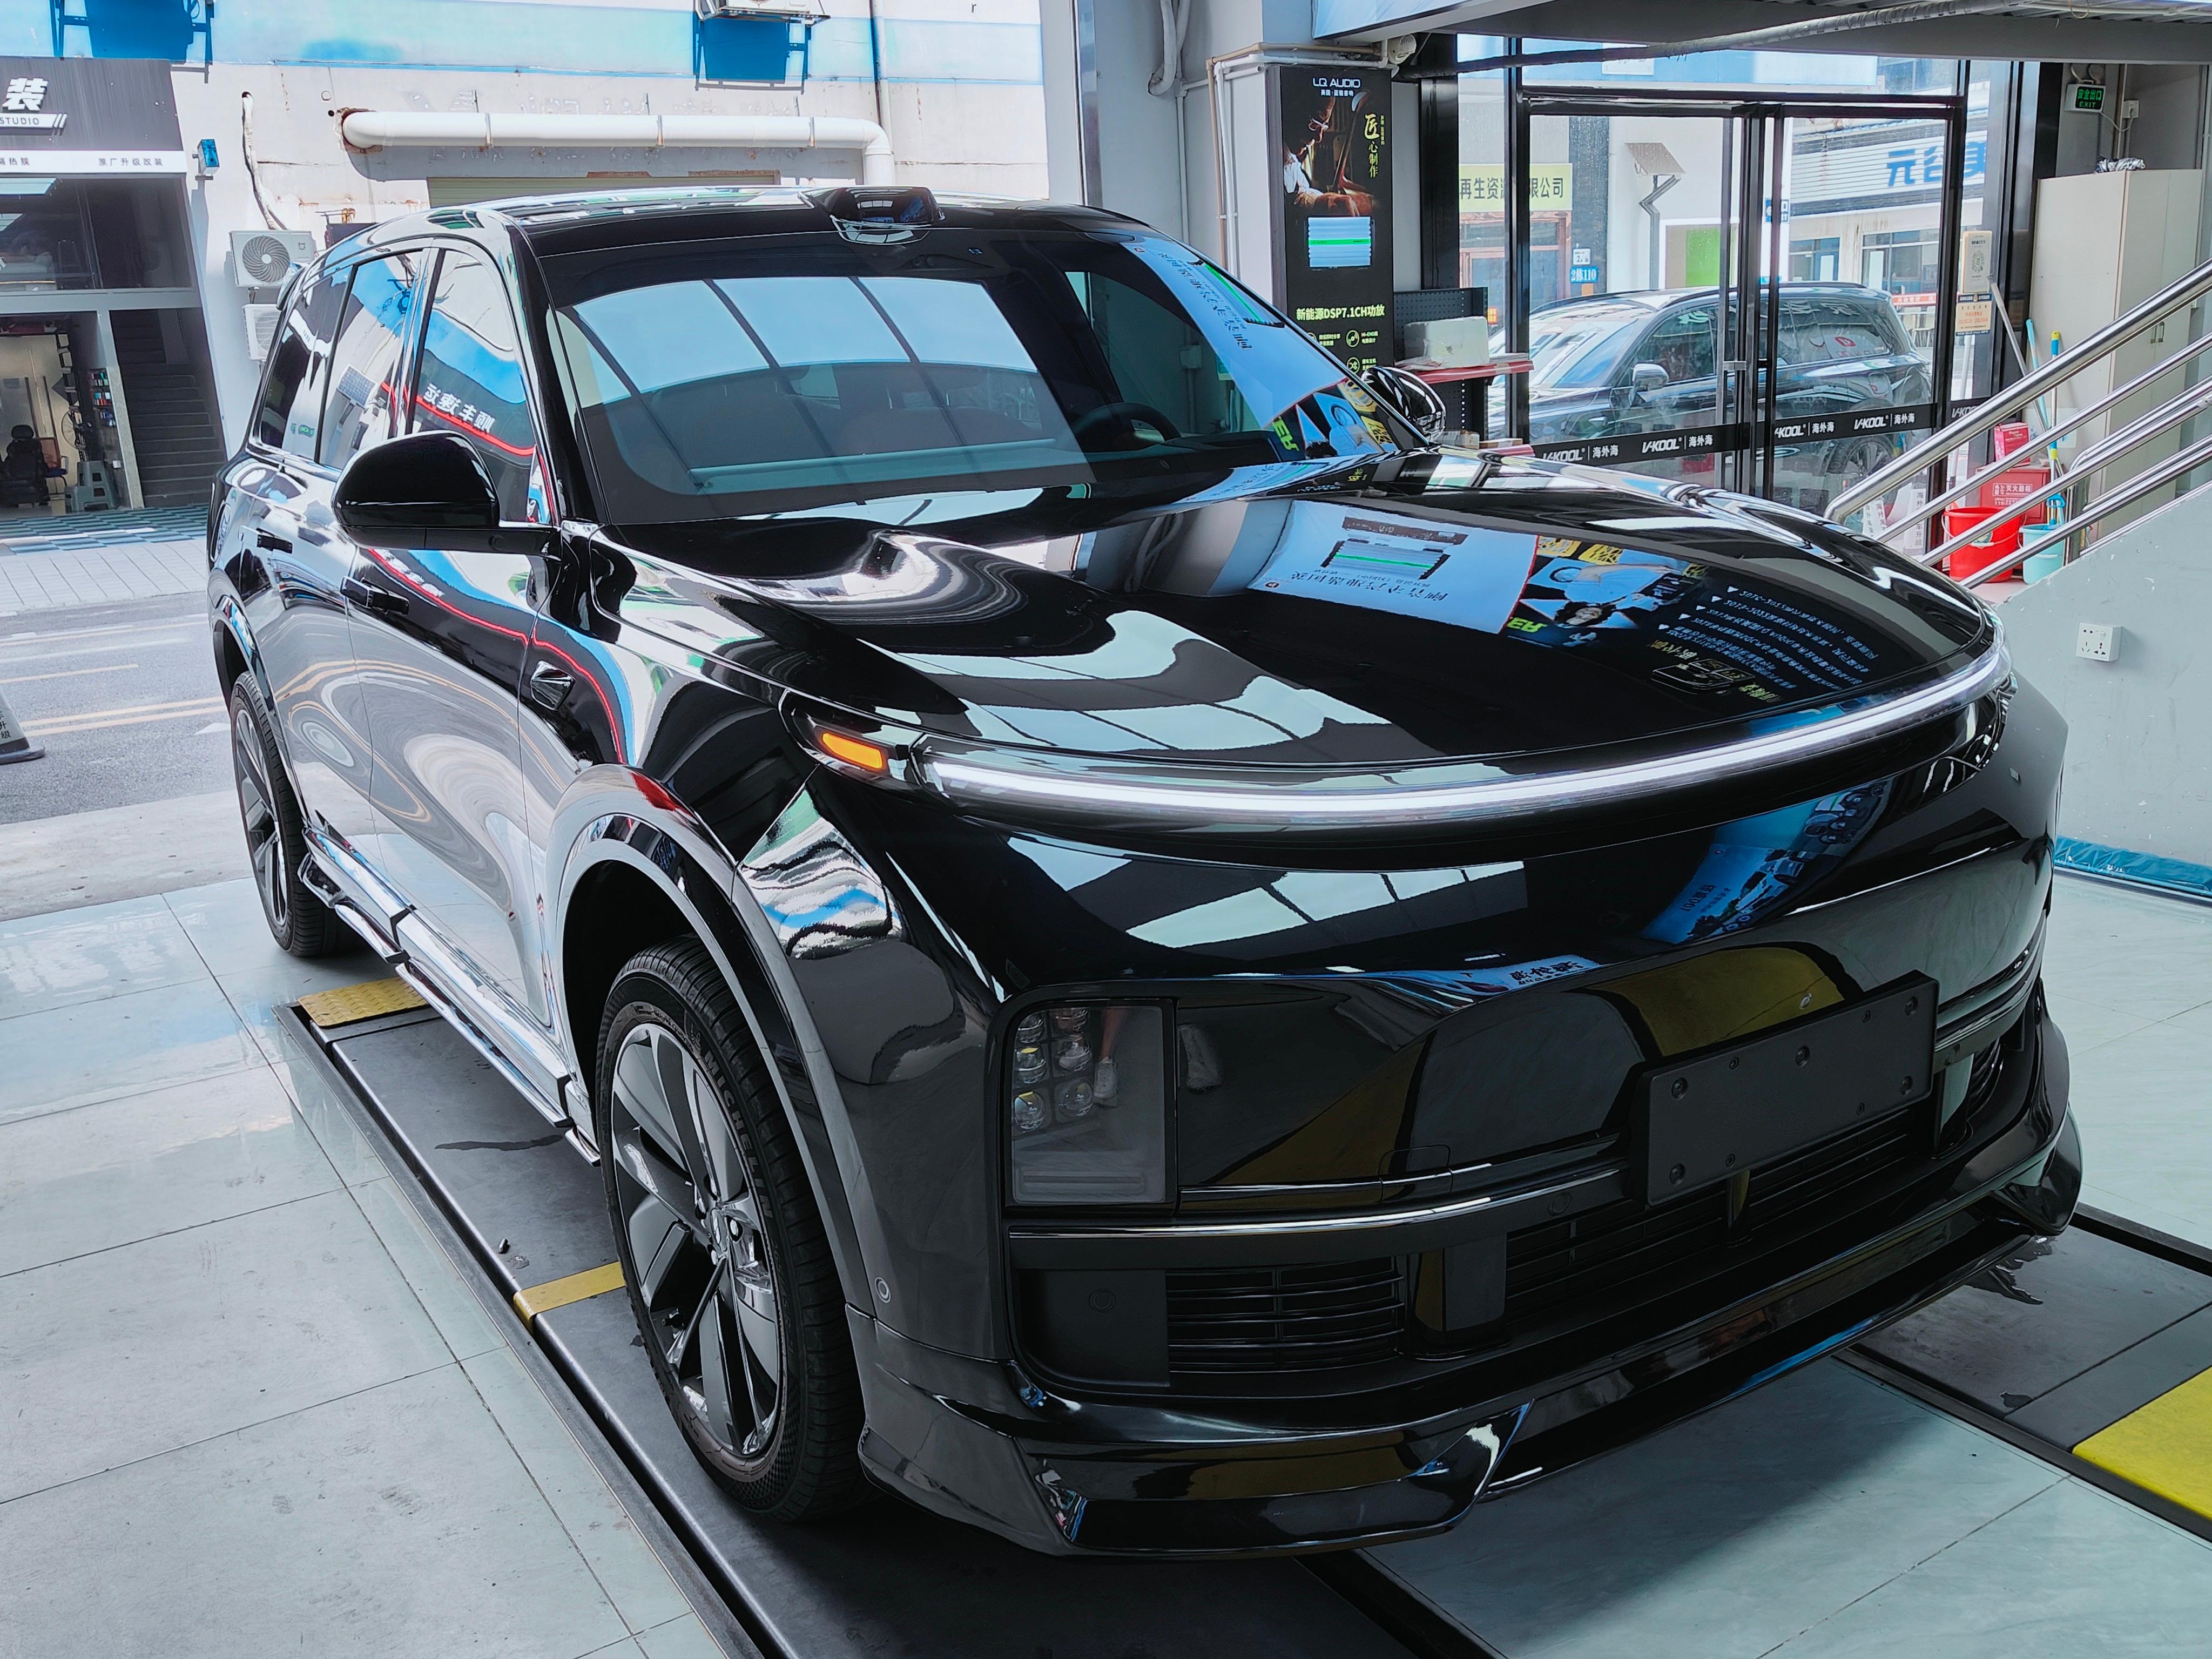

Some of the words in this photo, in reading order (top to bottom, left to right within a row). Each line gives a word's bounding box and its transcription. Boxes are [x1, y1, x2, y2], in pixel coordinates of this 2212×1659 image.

[1313, 78, 1328, 87] LQ
[1330, 78, 1361, 88] AUDIO
[2, 78, 48, 112] 装
[1296, 304, 1385, 321] 新能源DSP7.1CH功放
[1812, 422, 1835, 434] 海外海
[1854, 416, 1886, 430] V-KOOL
[1894, 413, 1915, 425] 海外海
[1592, 444, 1618, 458] 海外海
[1642, 437, 1681, 454] V-KOOL
[1688, 434, 1714, 448] 海外海
[704, 1050, 773, 1218] MICHELIN
